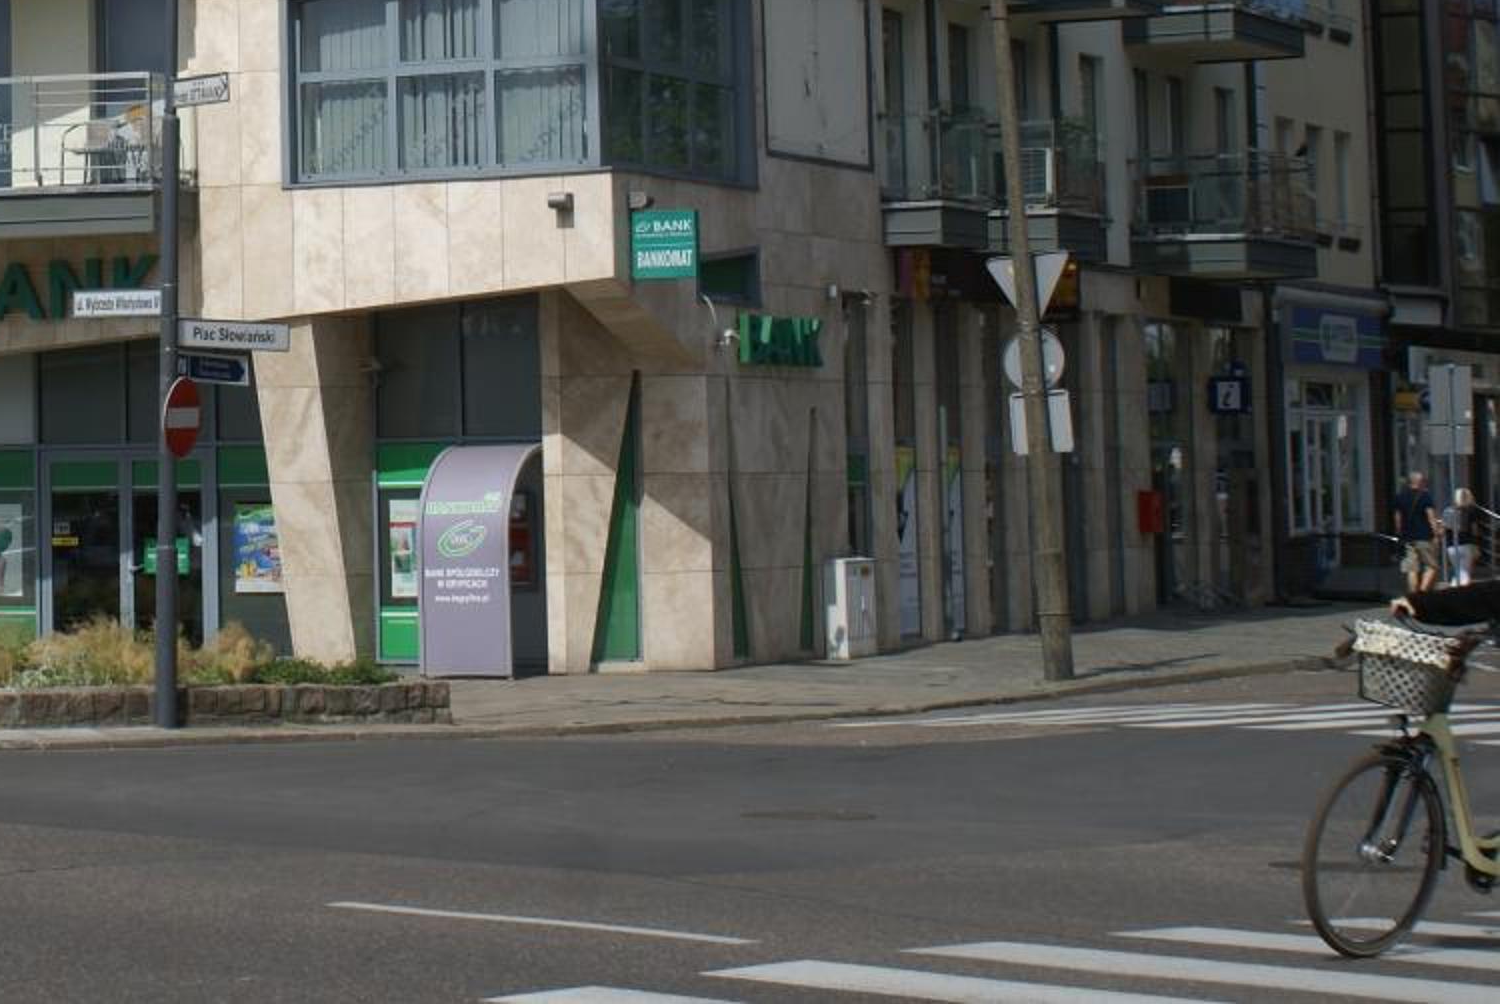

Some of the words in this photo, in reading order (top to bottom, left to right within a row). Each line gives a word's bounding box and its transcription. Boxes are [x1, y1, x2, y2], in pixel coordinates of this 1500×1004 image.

[654, 220, 692, 232] BANK
[637, 249, 692, 269] BANKOMAT
[193, 326, 216, 341] Plac
[219, 327, 276, 344] Słowiański
[740, 314, 822, 366] BANK
